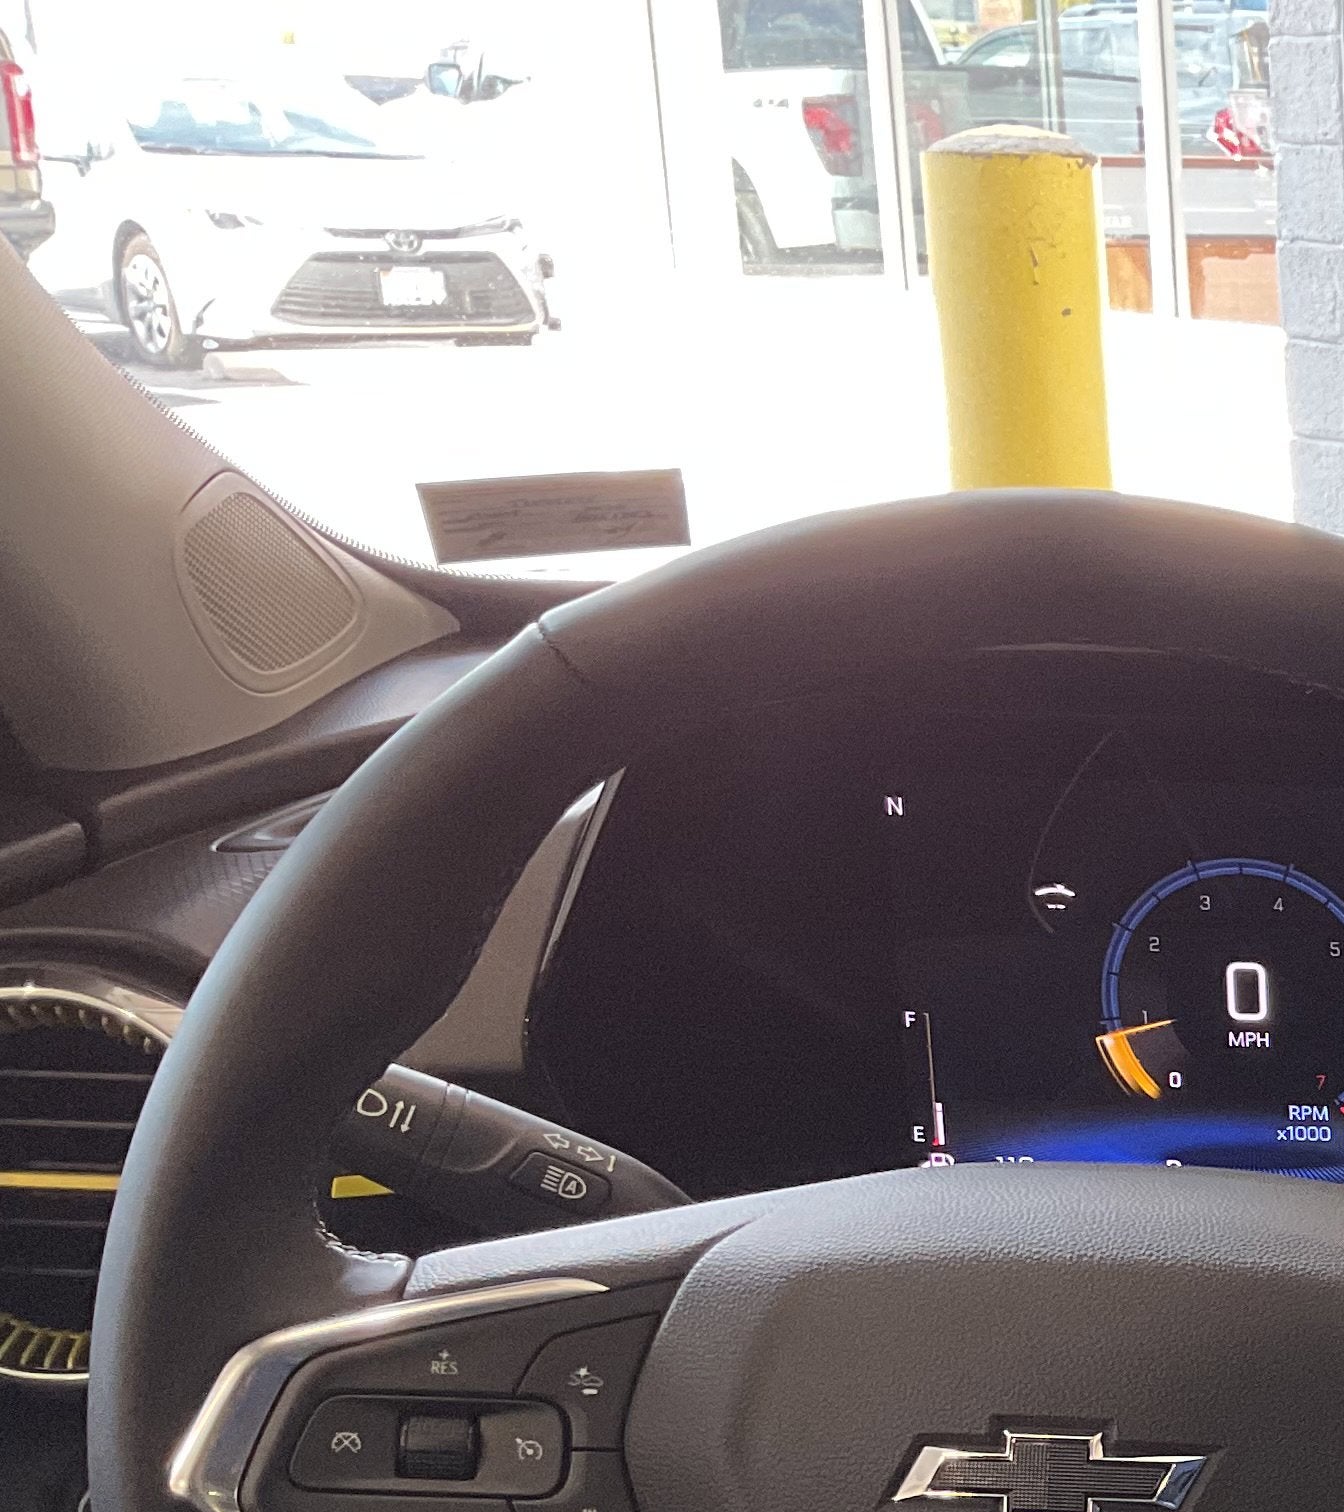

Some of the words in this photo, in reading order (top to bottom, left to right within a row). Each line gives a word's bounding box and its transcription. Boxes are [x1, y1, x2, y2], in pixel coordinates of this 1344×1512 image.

[886, 797, 903, 815] N
[1200, 896, 1210, 910] 3
[1274, 898, 1283, 911] 4
[1150, 937, 1160, 951] 2
[1330, 942, 1340, 956] 5
[1226, 962, 1269, 1023] 0
[905, 1011, 915, 1027] F
[1229, 1032, 1269, 1047] MPH
[1169, 1072, 1182, 1088] 0
[1316, 1075, 1326, 1090] 7
[1289, 1105, 1329, 1121] RPM
[914, 1126, 925, 1142] E
[1277, 1126, 1331, 1141] x1000
[430, 1360, 458, 1375] RES
